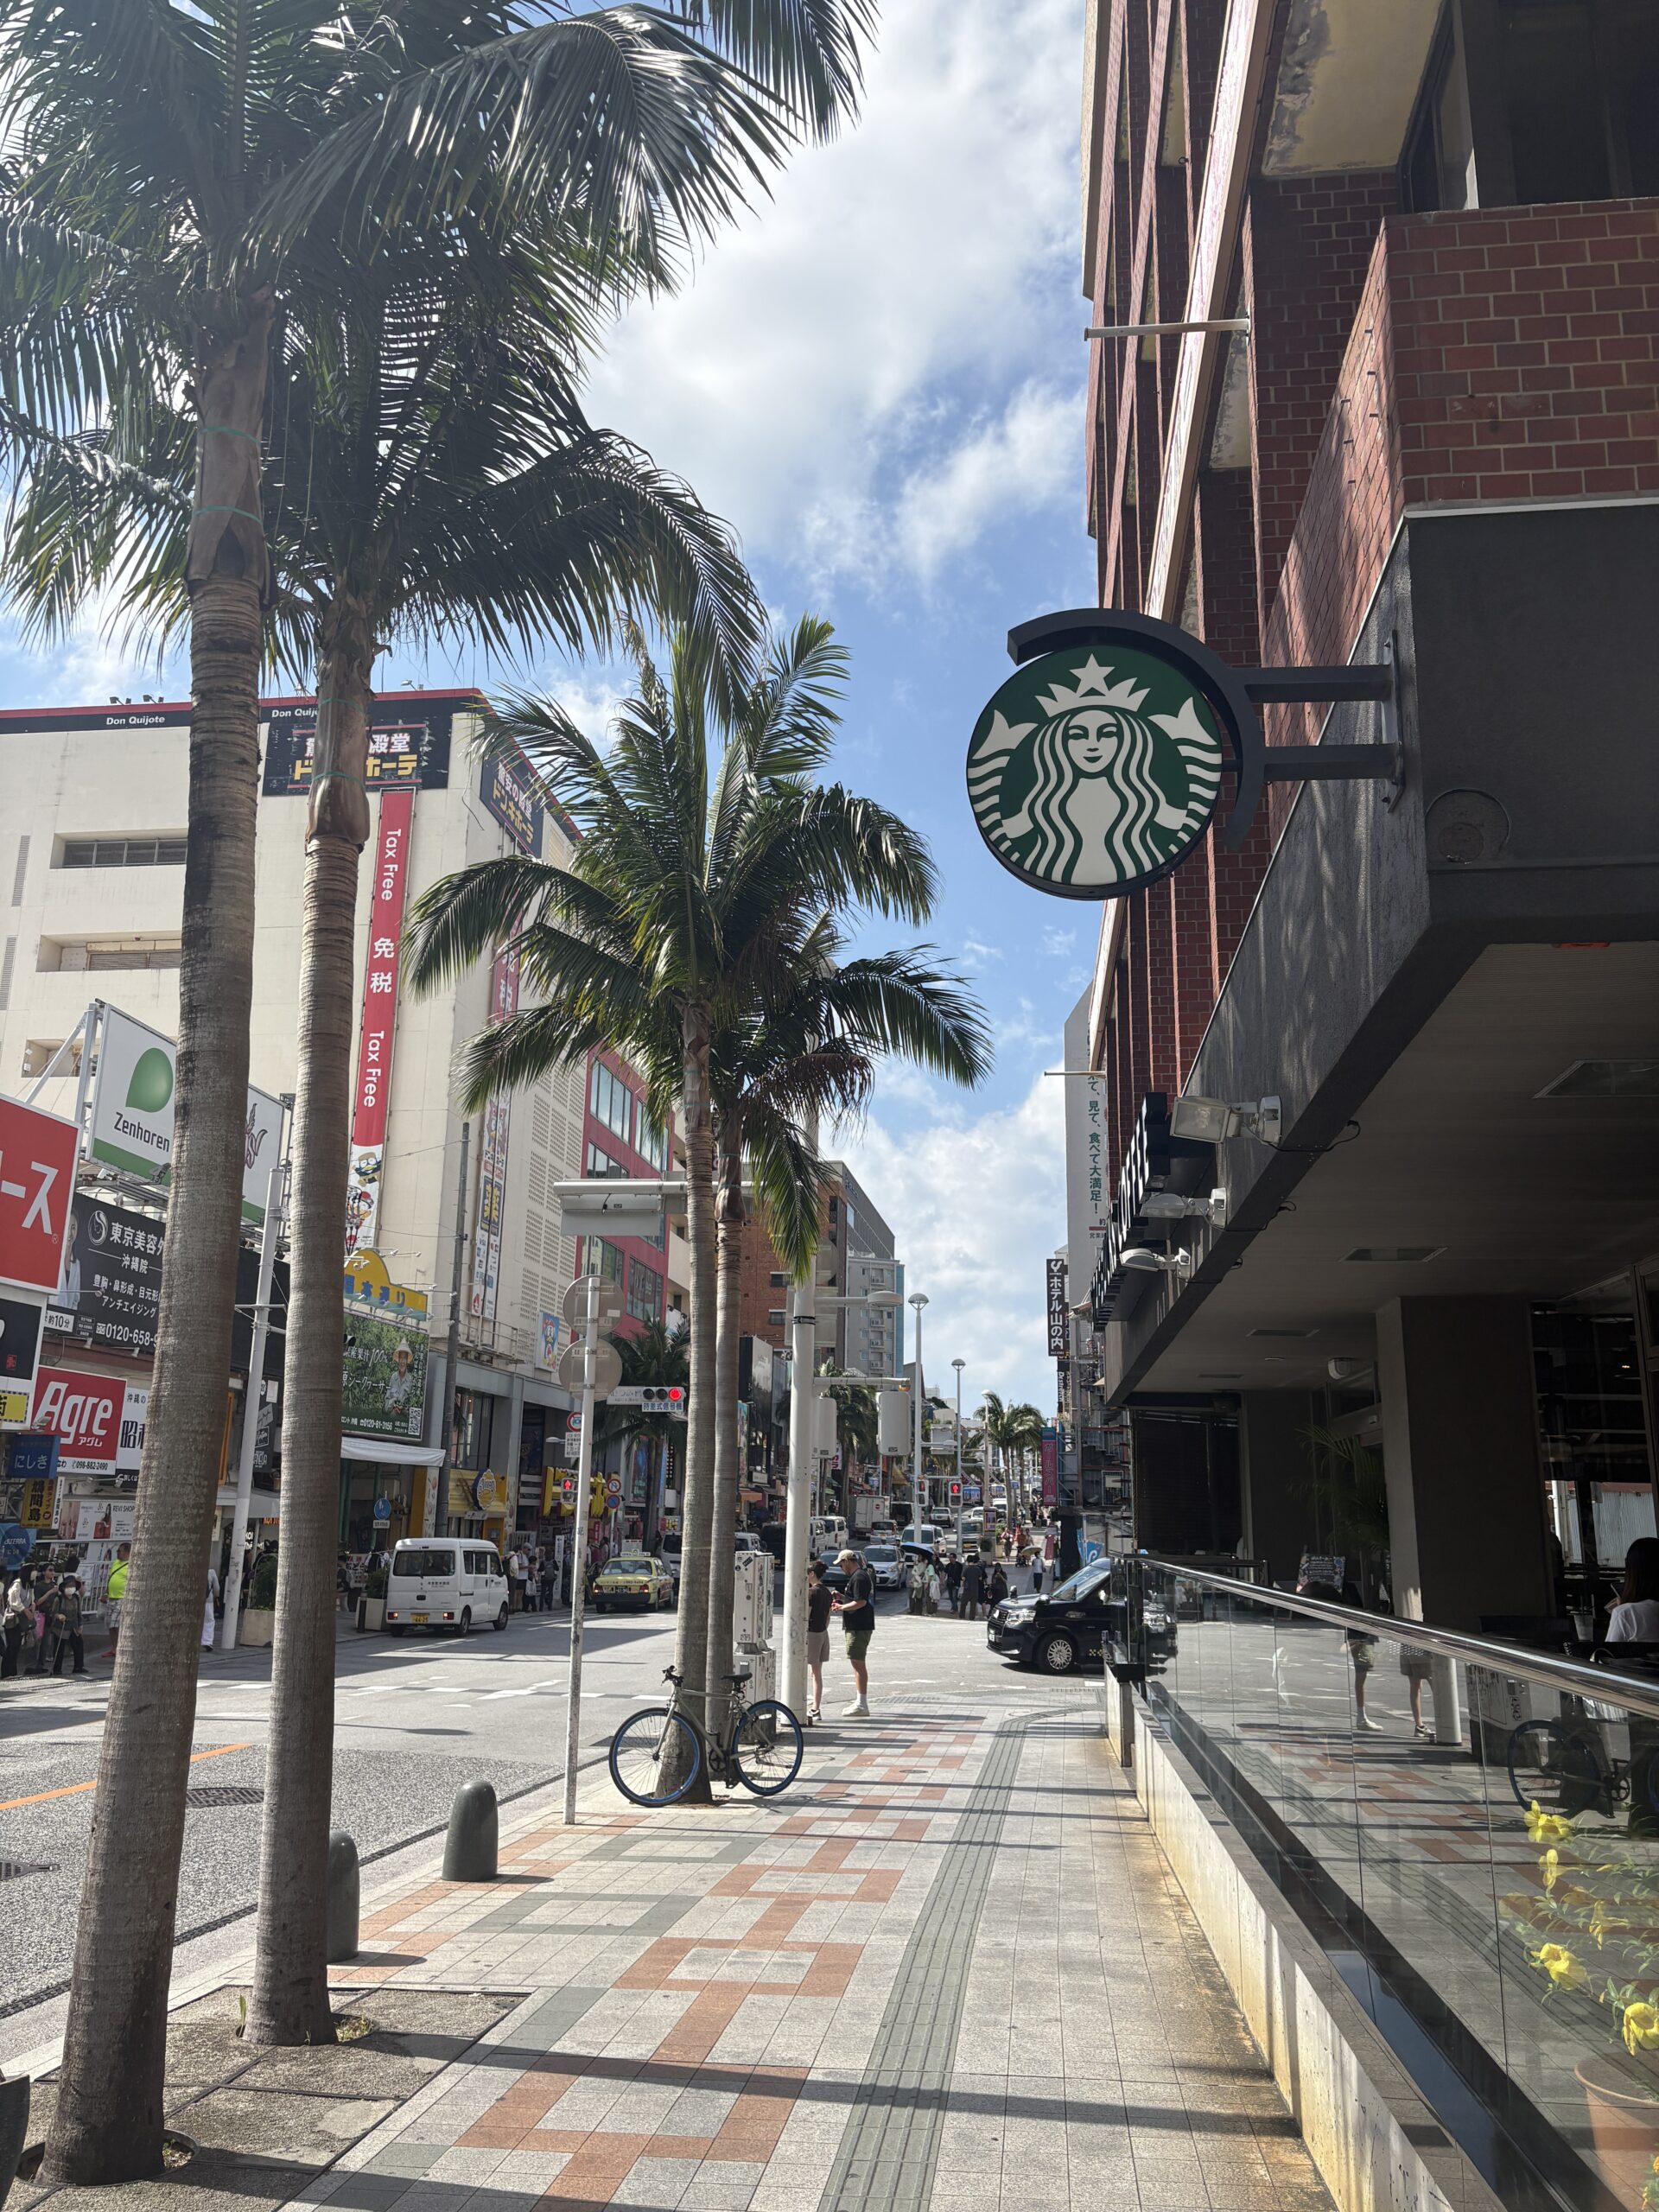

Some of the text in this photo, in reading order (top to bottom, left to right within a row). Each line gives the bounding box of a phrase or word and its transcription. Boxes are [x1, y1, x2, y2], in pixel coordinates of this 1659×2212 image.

[129, 715, 165, 725] Quijote
[271, 709, 291, 718] Don
[381, 829, 402, 901] Tax Free
[370, 938, 395, 993] 免税
[363, 1031, 385, 1108] Tax Free
[114, 1112, 170, 1153] Zenhoren
[0, 1150, 60, 1236] ース
[122, 1253, 149, 1274] 沖縄院
[92, 1274, 162, 1303] 豊胸・鼻形成・目元形
[102, 1295, 157, 1319] アンチエイジング
[1050, 1279, 1063, 1350] ホテル山の内
[33, 1382, 112, 1445] Agre
[643, 1402, 683, 1411] 時差式信号機
[78, 1437, 103, 1447] アグレ
[14, 1454, 48, 1470] にしき
[1044, 1444, 1054, 1494] ガールズバー
